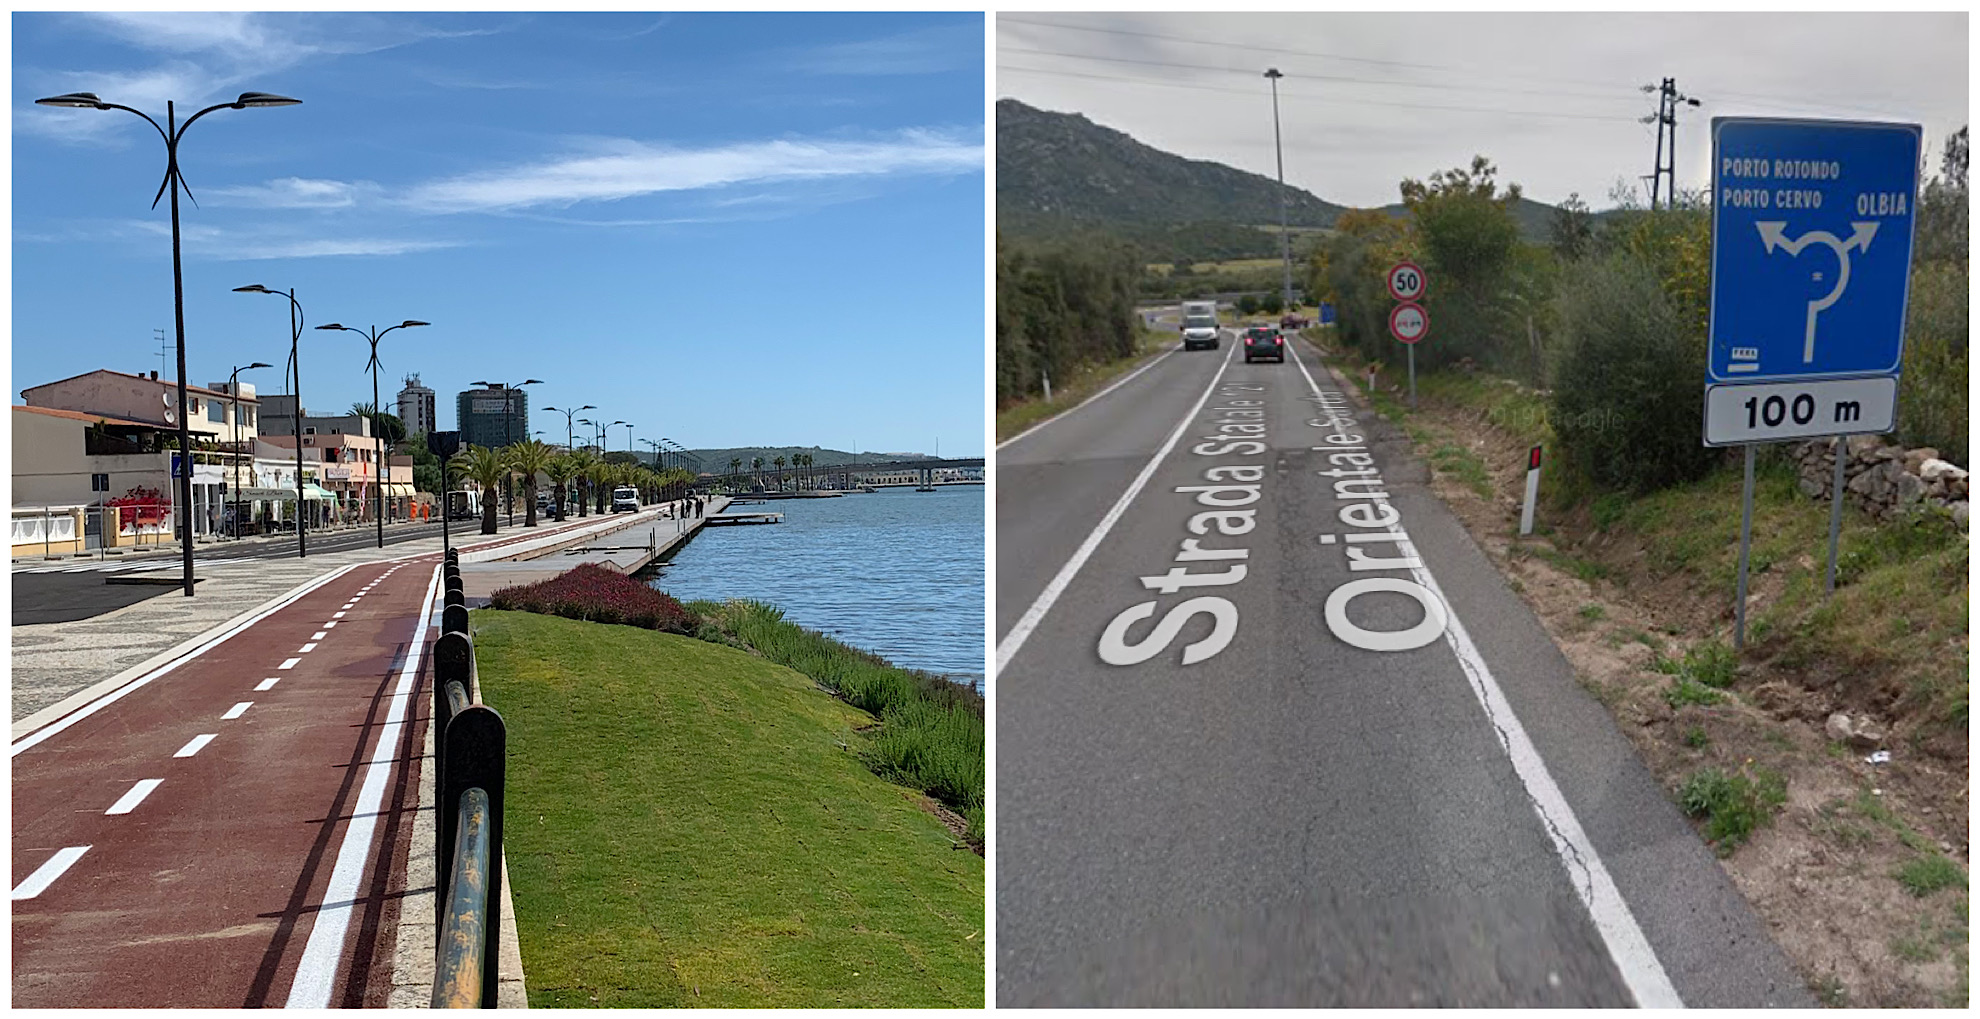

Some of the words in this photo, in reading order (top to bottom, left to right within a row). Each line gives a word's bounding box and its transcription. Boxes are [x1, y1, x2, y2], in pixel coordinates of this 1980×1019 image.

[1722, 158, 1769, 178] PORTO
[1774, 158, 1841, 179] ROTONDO
[1722, 188, 1769, 209] PORTO
[1776, 190, 1822, 209] CERVO
[1857, 193, 1907, 217] OLBIA
[1396, 273, 1417, 291] 50
[1744, 394, 1815, 429] 100
[1834, 399, 1860, 423] m
